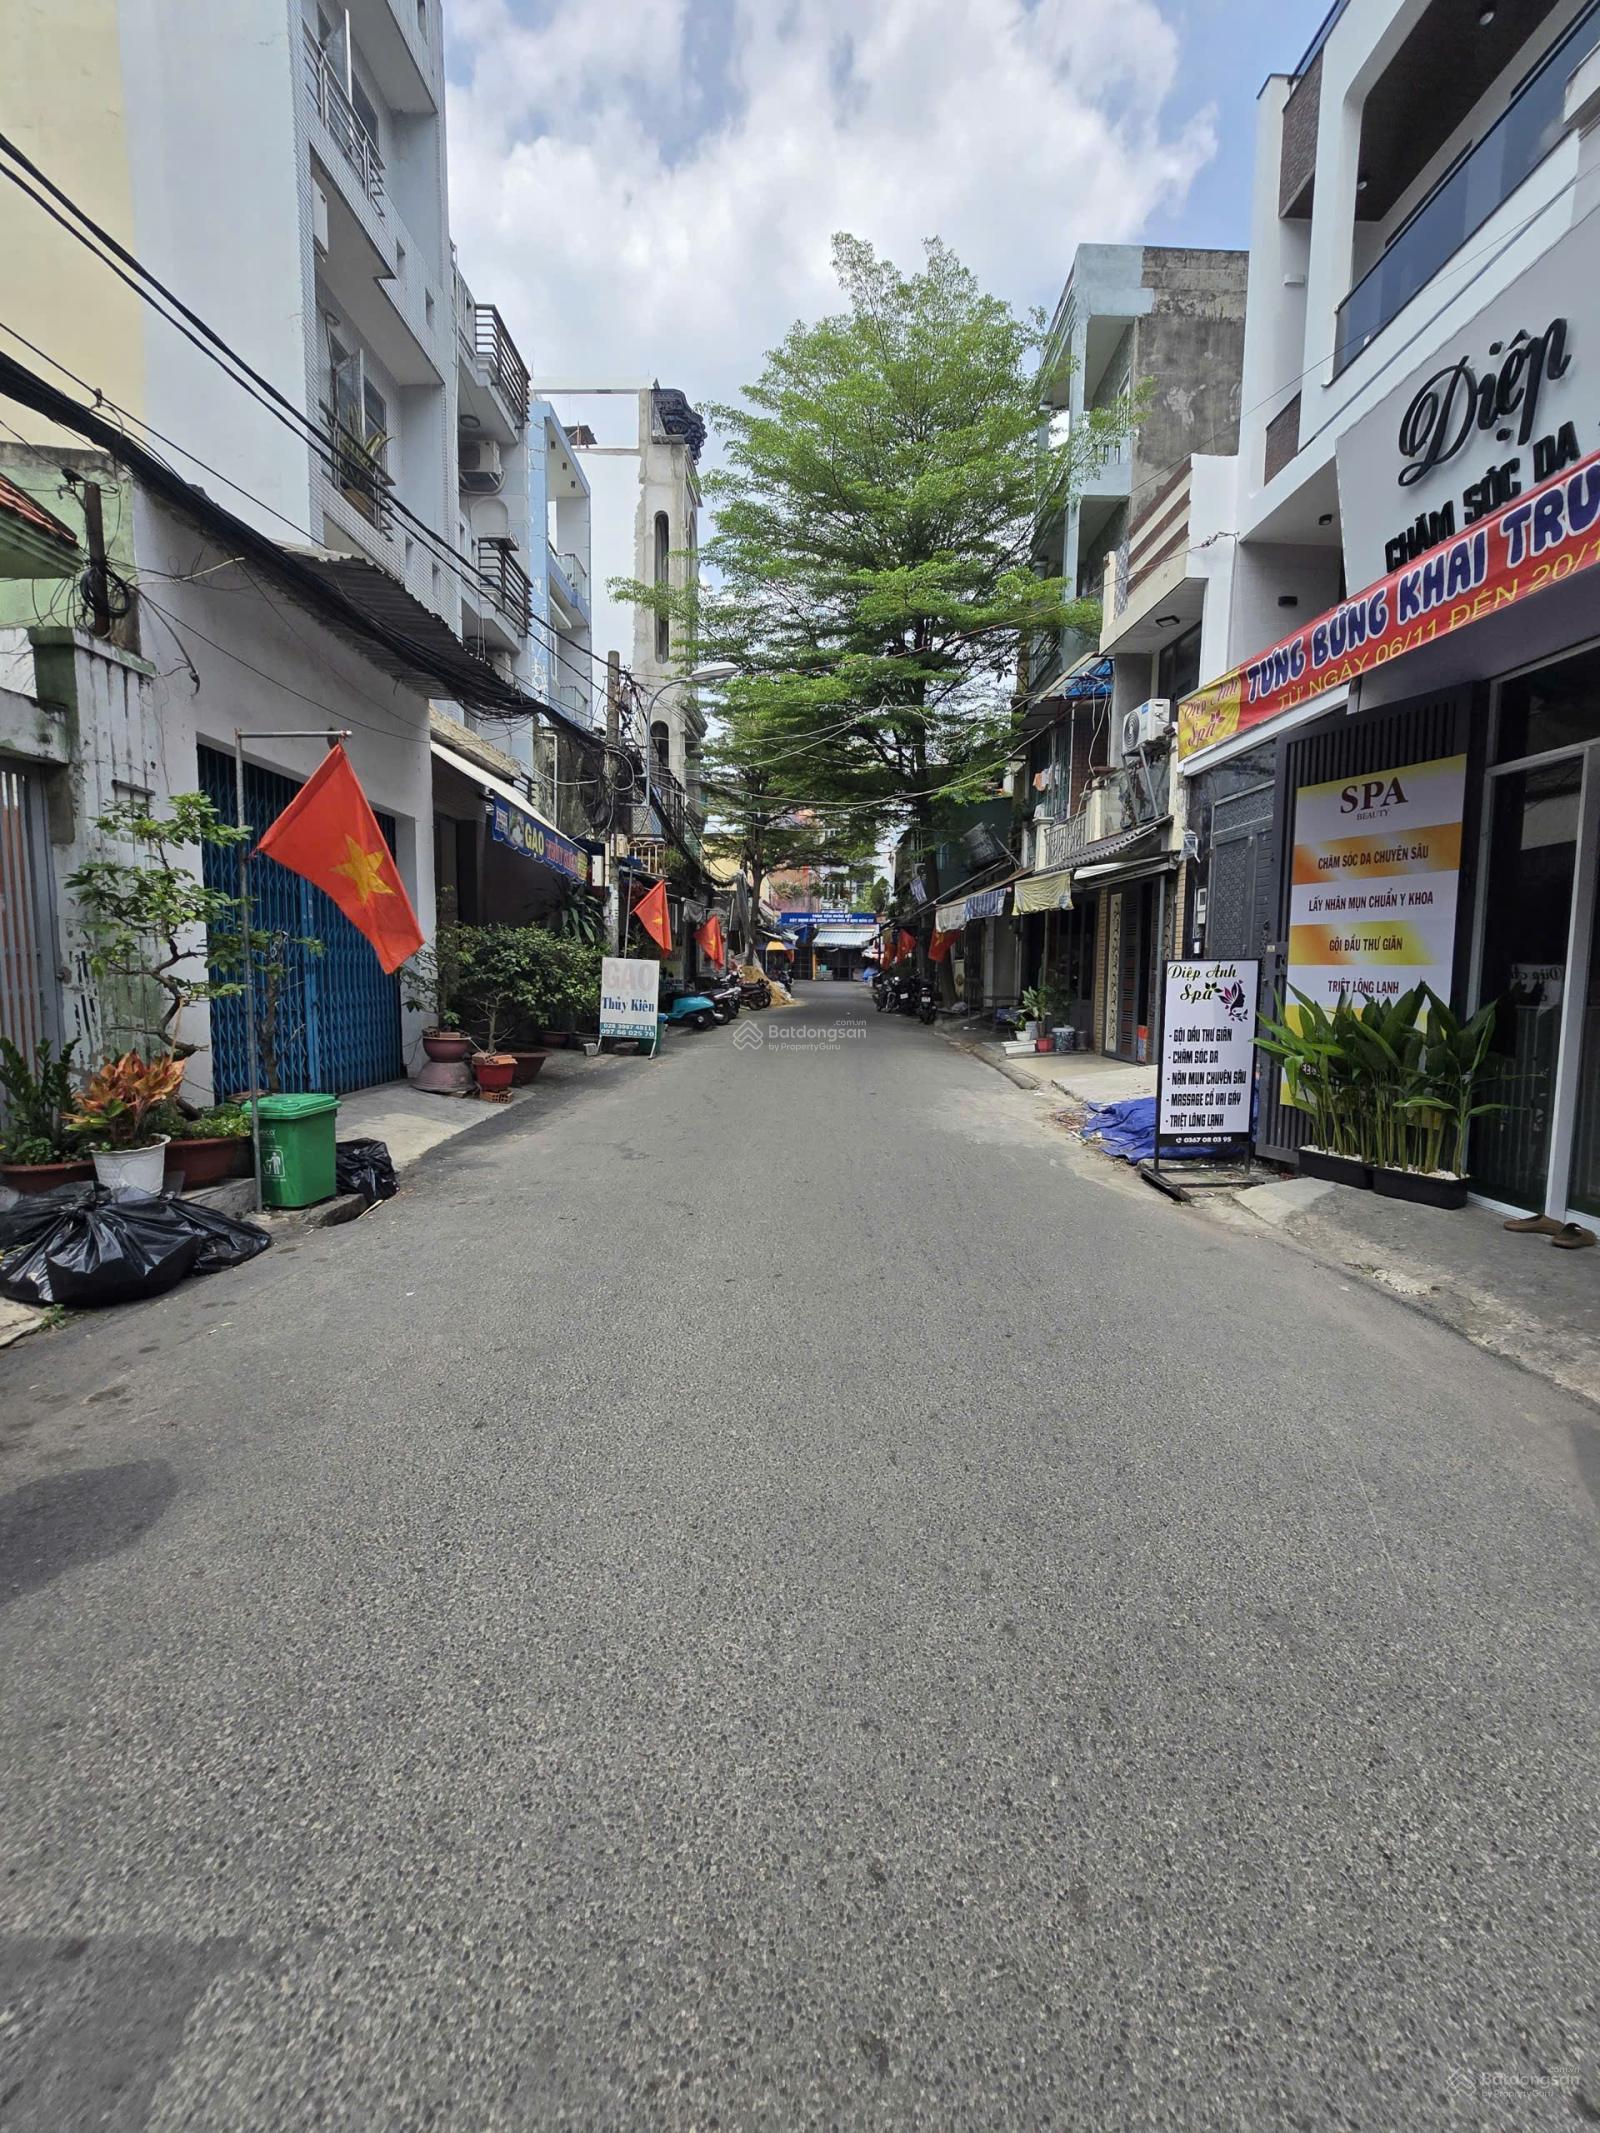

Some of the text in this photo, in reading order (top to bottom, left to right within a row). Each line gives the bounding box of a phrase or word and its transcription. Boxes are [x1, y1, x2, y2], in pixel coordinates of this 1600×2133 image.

[1398, 318, 1572, 487] Diệp
[1384, 421, 1581, 574] CHĂM SÓC DA
[1397, 527, 1489, 626] KHAI
[1309, 652, 1370, 697] NGÀY
[1375, 618, 1438, 665] 06/11
[1448, 578, 1519, 633] ĐẾN
[1187, 722, 1216, 748] Spa
[1340, 776, 1409, 814] SPA
[1356, 808, 1392, 821] BEAUTY
[524, 822, 545, 858] GẠO
[1318, 843, 1429, 870] CHĂM SÓC DA CHUYÊN SÂU
[1308, 887, 1433, 912] LẤY NHÂN MỤN CHUẨN Y KHOA
[1329, 936, 1342, 954] GỘI
[1363, 935, 1381, 951] THƯ
[1382, 934, 1403, 950] GIÃN
[602, 961, 655, 995] GẠO
[1168, 964, 1201, 981] Diệp
[1180, 983, 1213, 1004] Spa
[1352, 977, 1374, 993] LÔNG
[1376, 981, 1399, 996] LẠNH
[602, 996, 655, 1013] Thủy Kiên
[1173, 1026, 1185, 1045] GỘI
[1202, 1027, 1215, 1042] THƯ
[1173, 1047, 1219, 1063] CHĂM SÓC DA
[1172, 1068, 1247, 1088] NẶN MỤN CHUYÊN SÂU
[1171, 1087, 1242, 1106] MASSAGE CỔ VAI GÁY
[1170, 1112, 1224, 1131] TRIỆT LÔNG LẠNH
